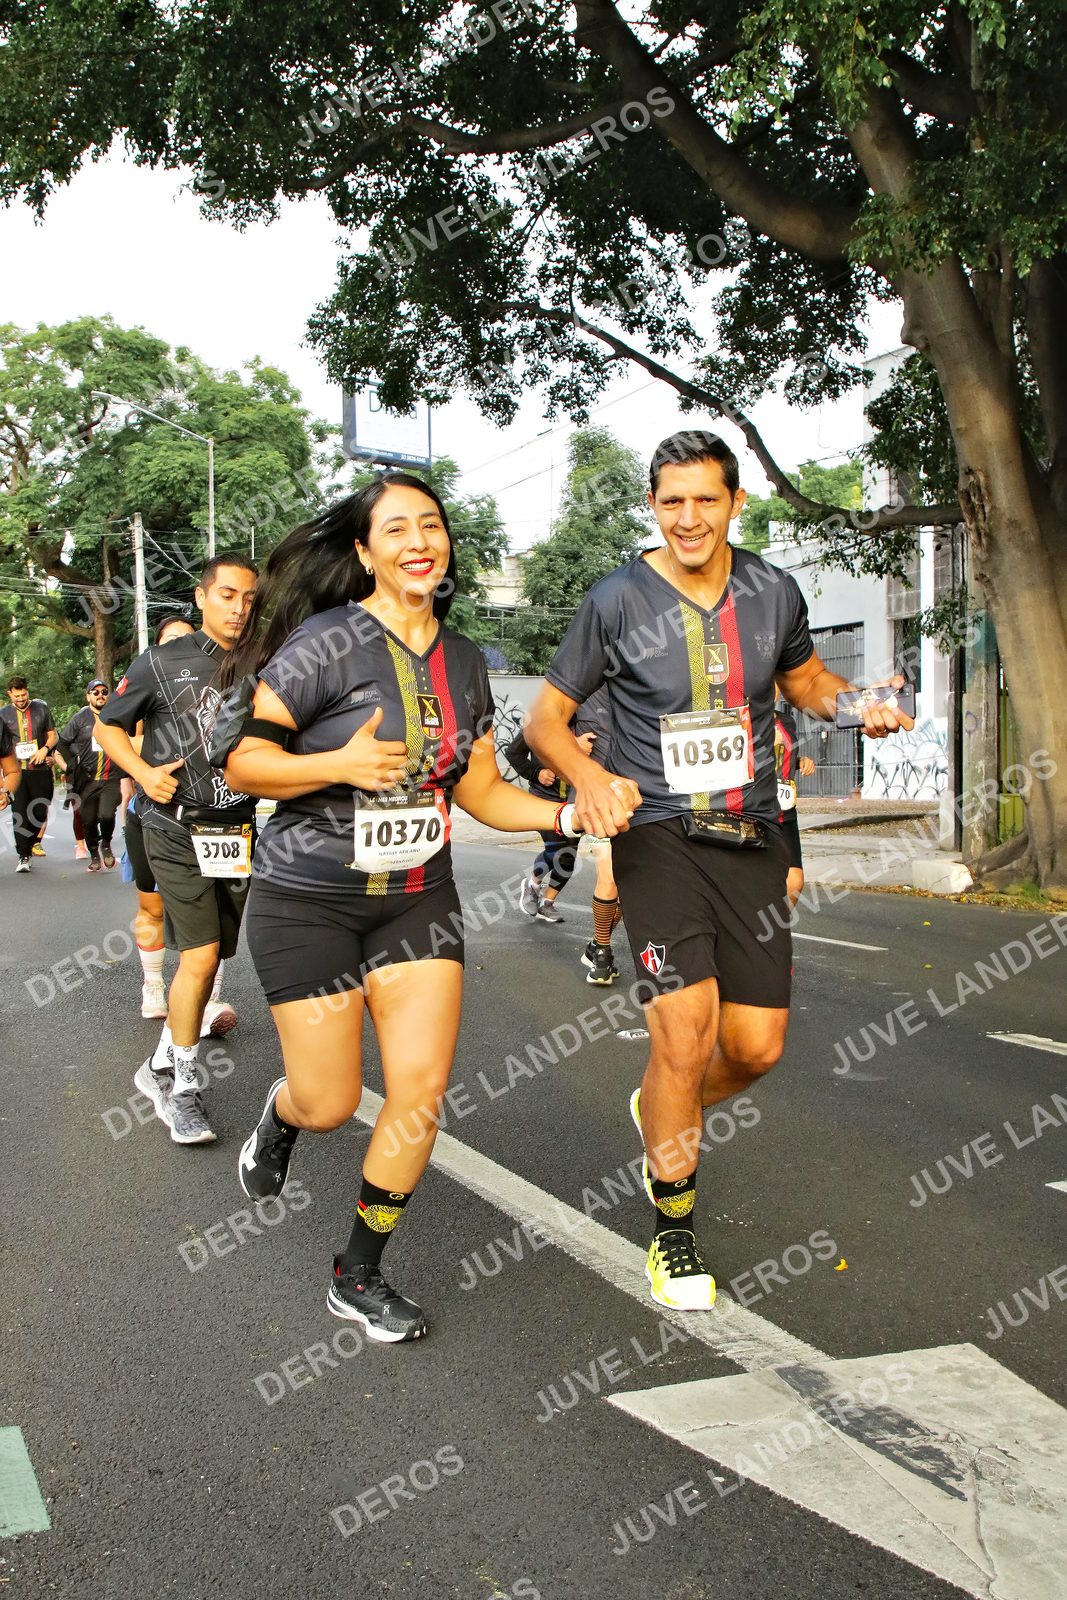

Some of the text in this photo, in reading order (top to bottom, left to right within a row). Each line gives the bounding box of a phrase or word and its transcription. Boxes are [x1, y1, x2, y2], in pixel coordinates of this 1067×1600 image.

[667, 735, 745, 767] 10369
[360, 817, 441, 847] 10370
[201, 841, 241, 859] 3708
